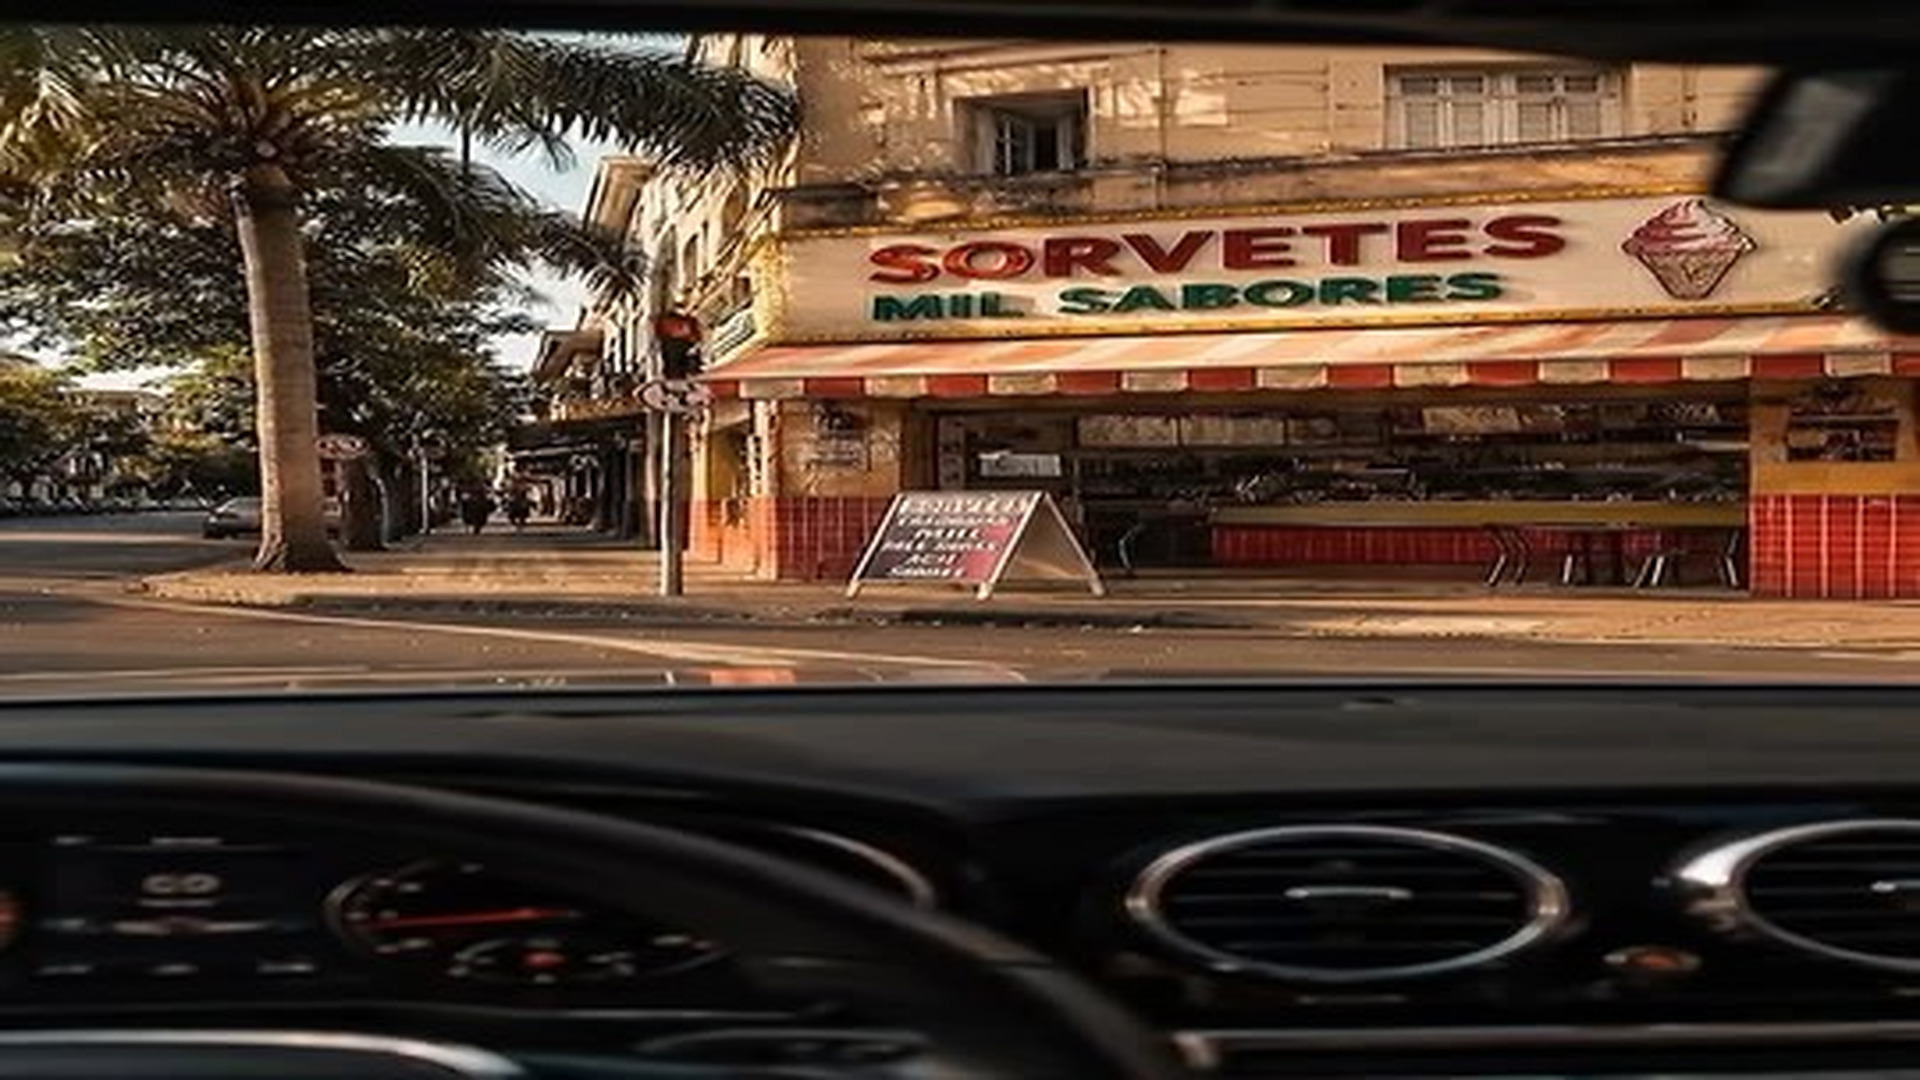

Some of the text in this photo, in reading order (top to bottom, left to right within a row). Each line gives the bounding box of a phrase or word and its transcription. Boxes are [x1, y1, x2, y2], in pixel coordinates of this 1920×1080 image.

[869, 215, 1566, 283] SORVETES
[873, 272, 1503, 321] MIL SABORES
